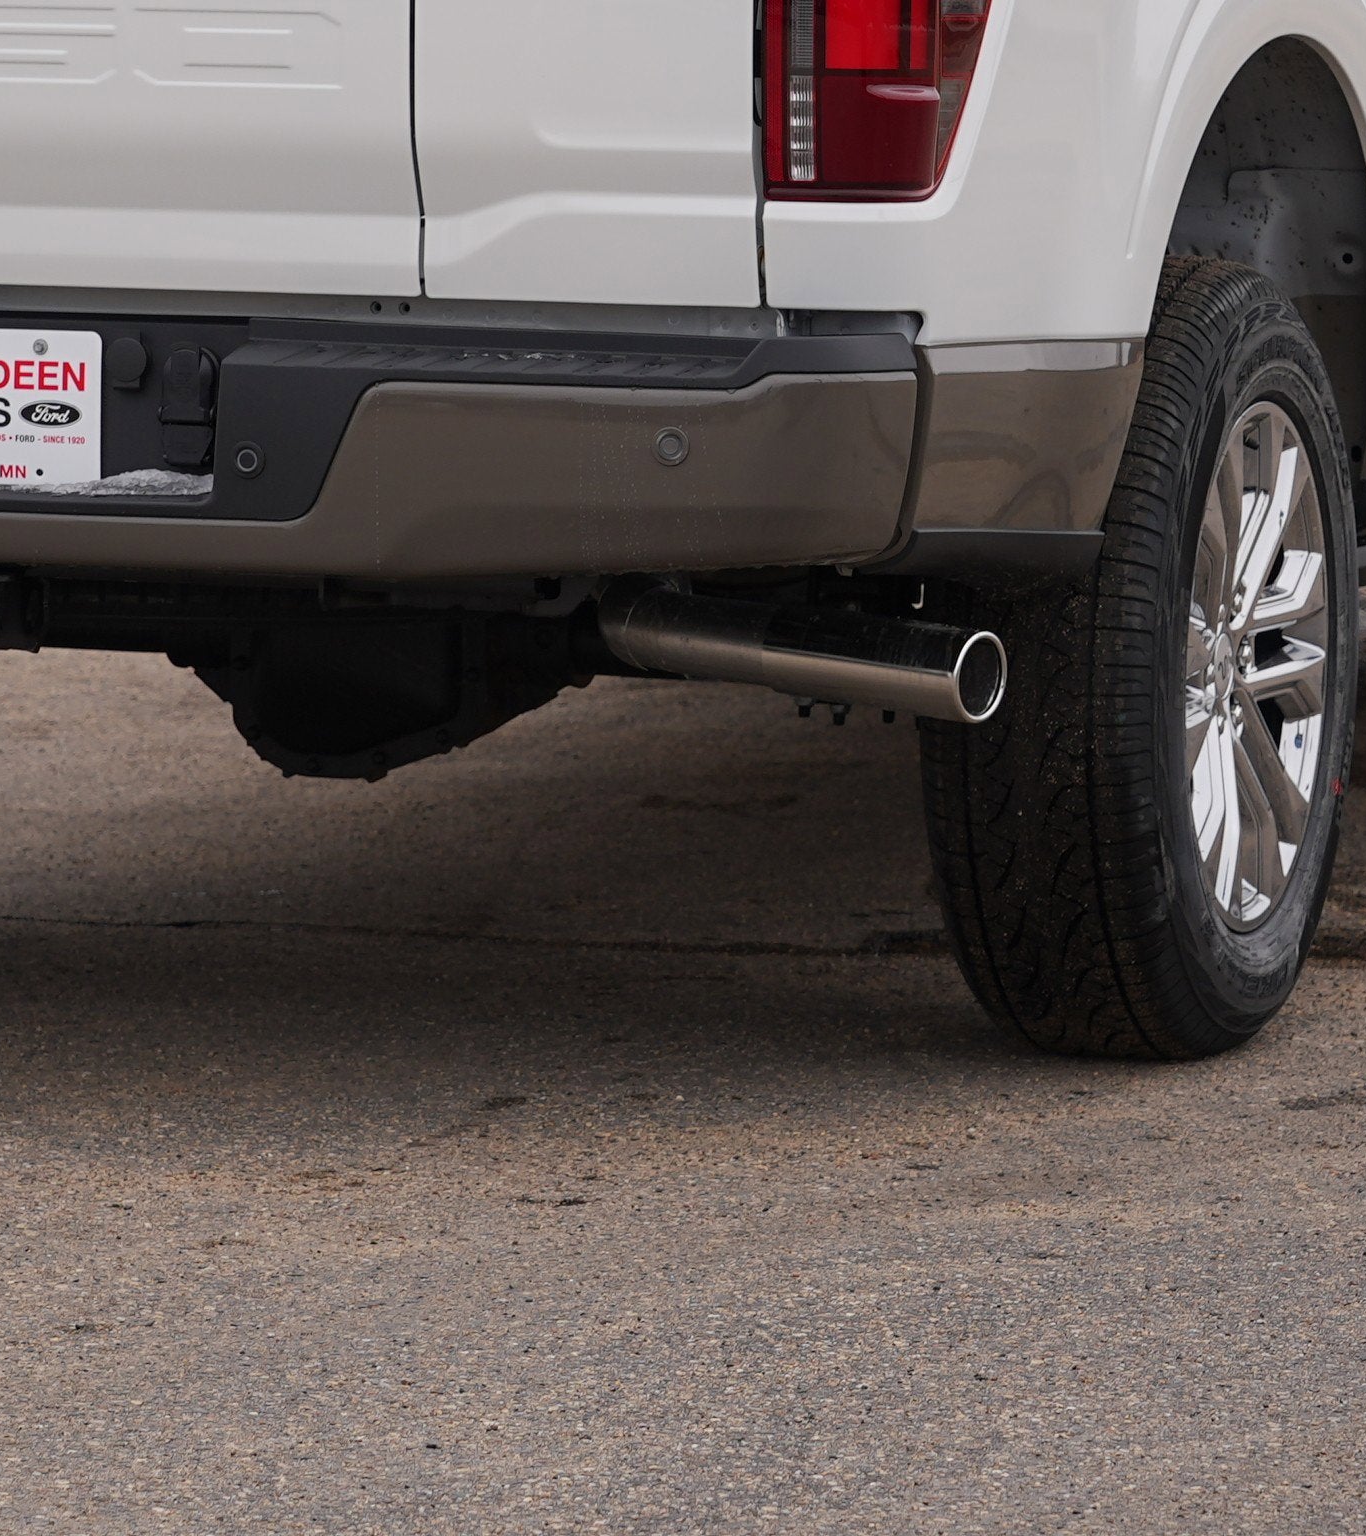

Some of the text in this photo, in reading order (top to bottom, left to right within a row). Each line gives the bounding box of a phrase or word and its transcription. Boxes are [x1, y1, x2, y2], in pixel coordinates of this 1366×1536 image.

[30, 403, 71, 424] Ford
[15, 434, 35, 443] FORD
[43, 435, 65, 444] SINCE
[68, 436, 86, 445] 1920
[0, 464, 27, 479] MN
